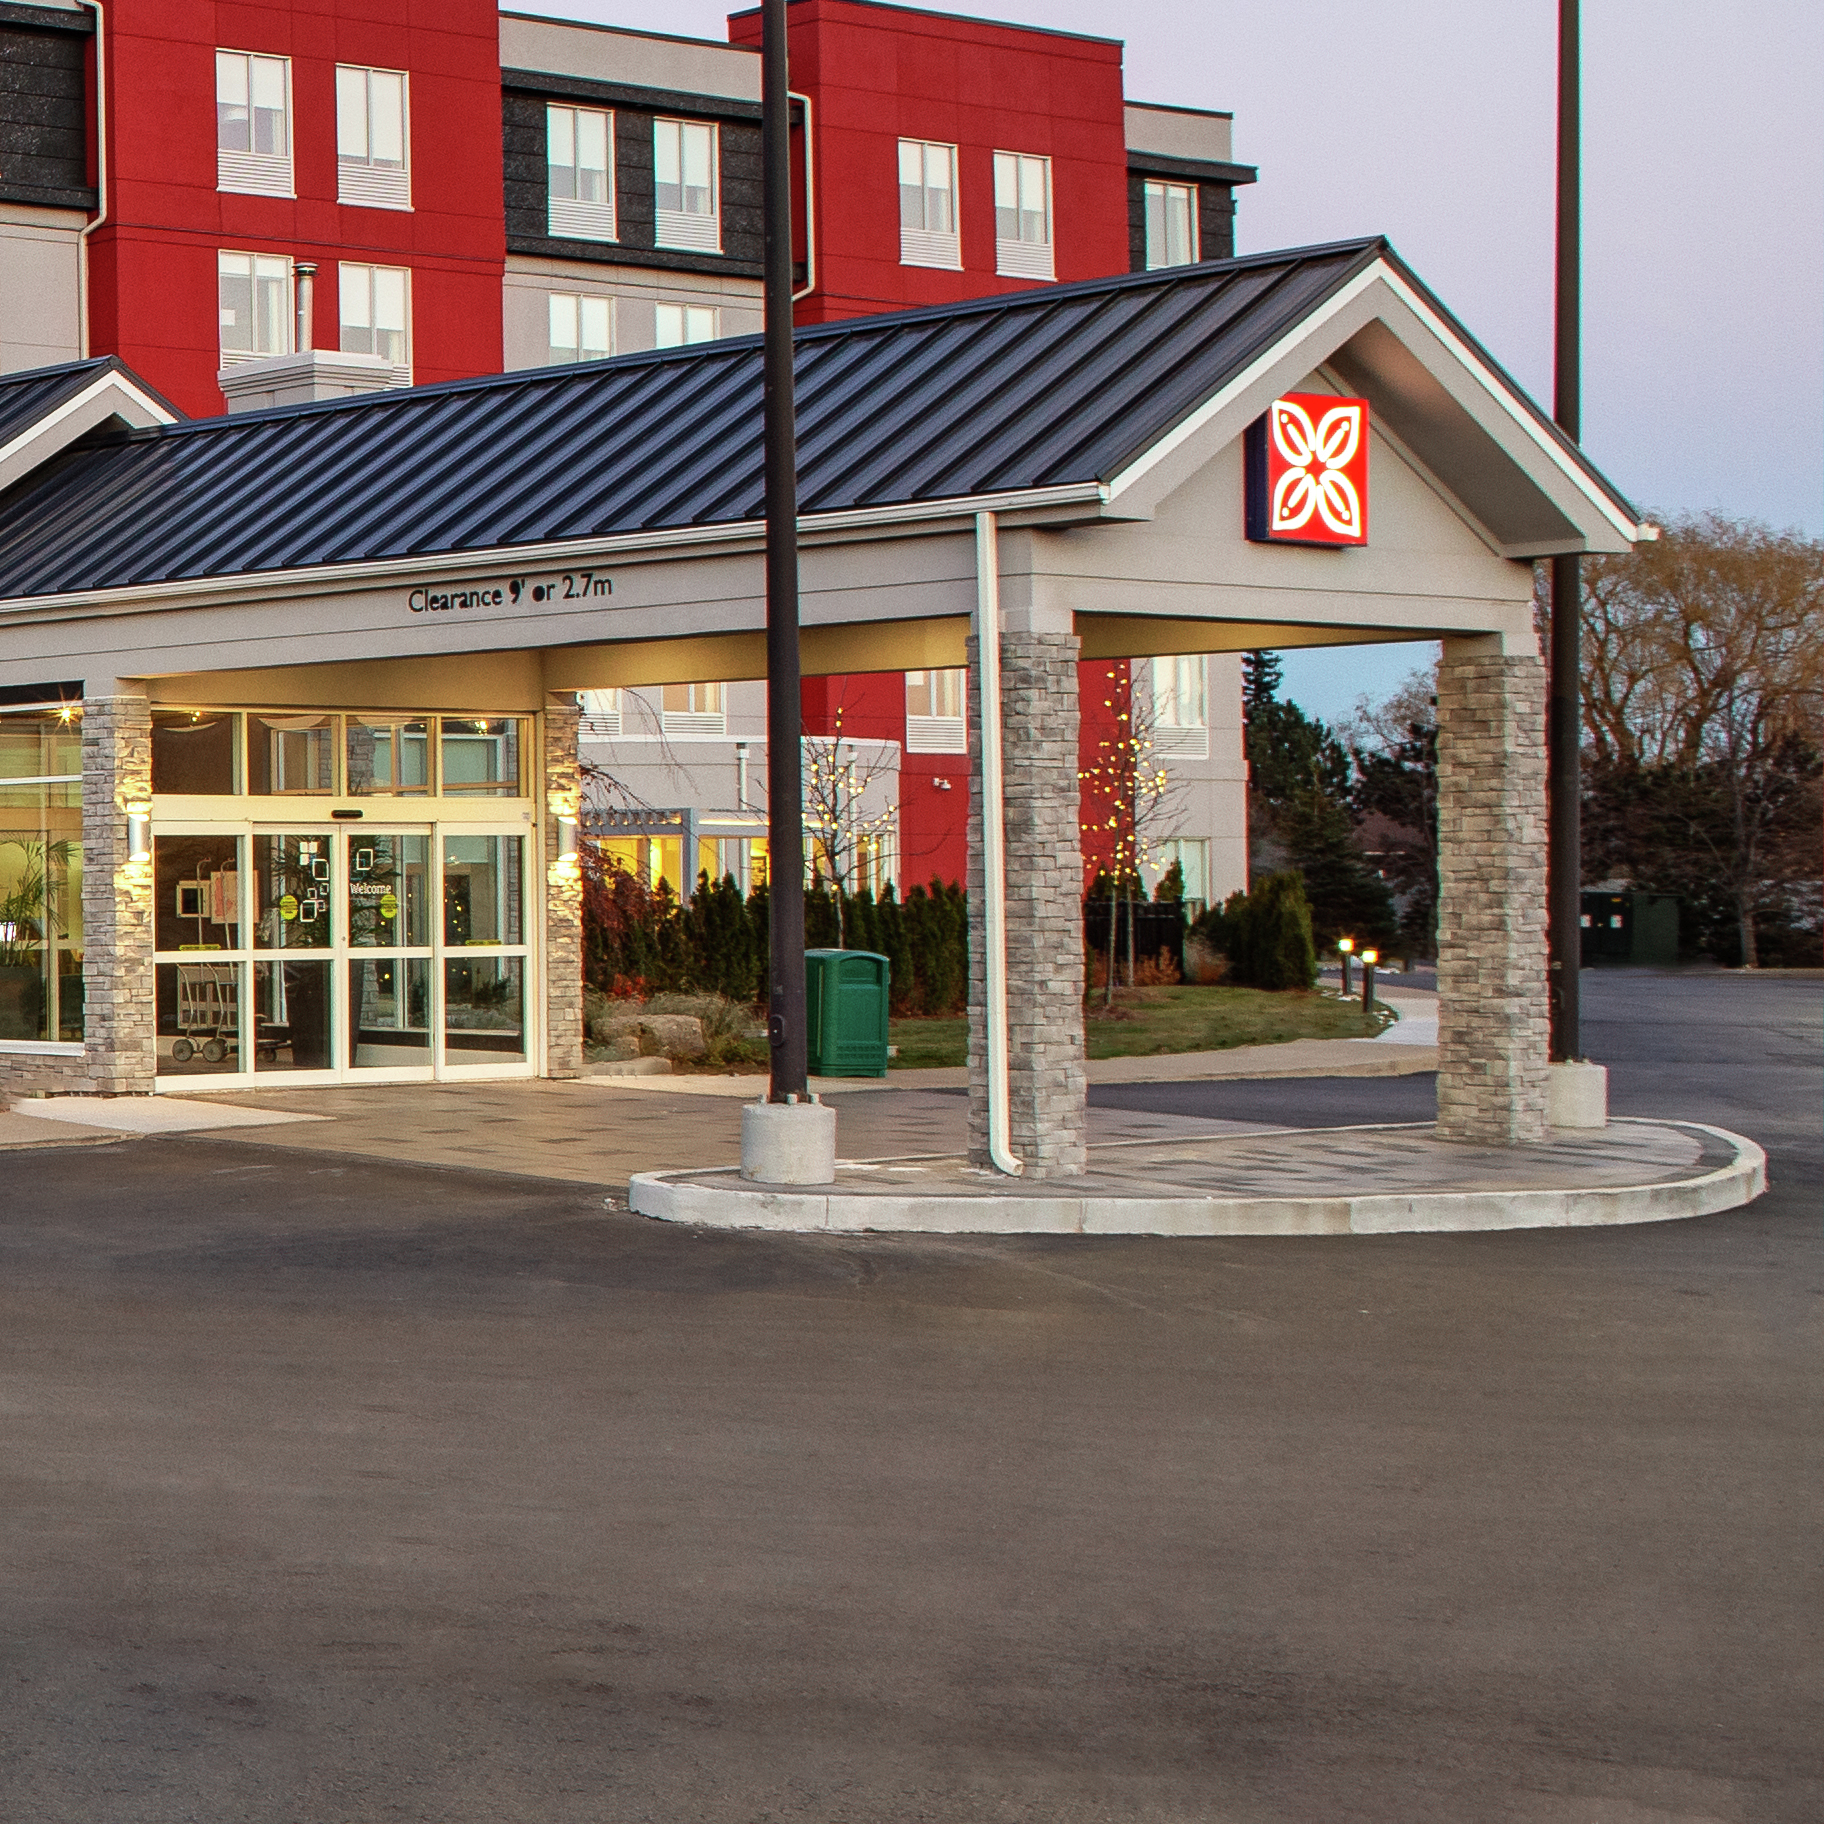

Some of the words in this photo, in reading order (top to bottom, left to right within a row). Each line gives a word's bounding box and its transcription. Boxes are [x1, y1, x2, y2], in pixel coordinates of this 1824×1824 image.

[408, 588, 503, 613] Clearance
[508, 578, 526, 605] 9'
[532, 583, 556, 603] or
[561, 573, 614, 600] 2.7m
[350, 882, 392, 895] Welcome
